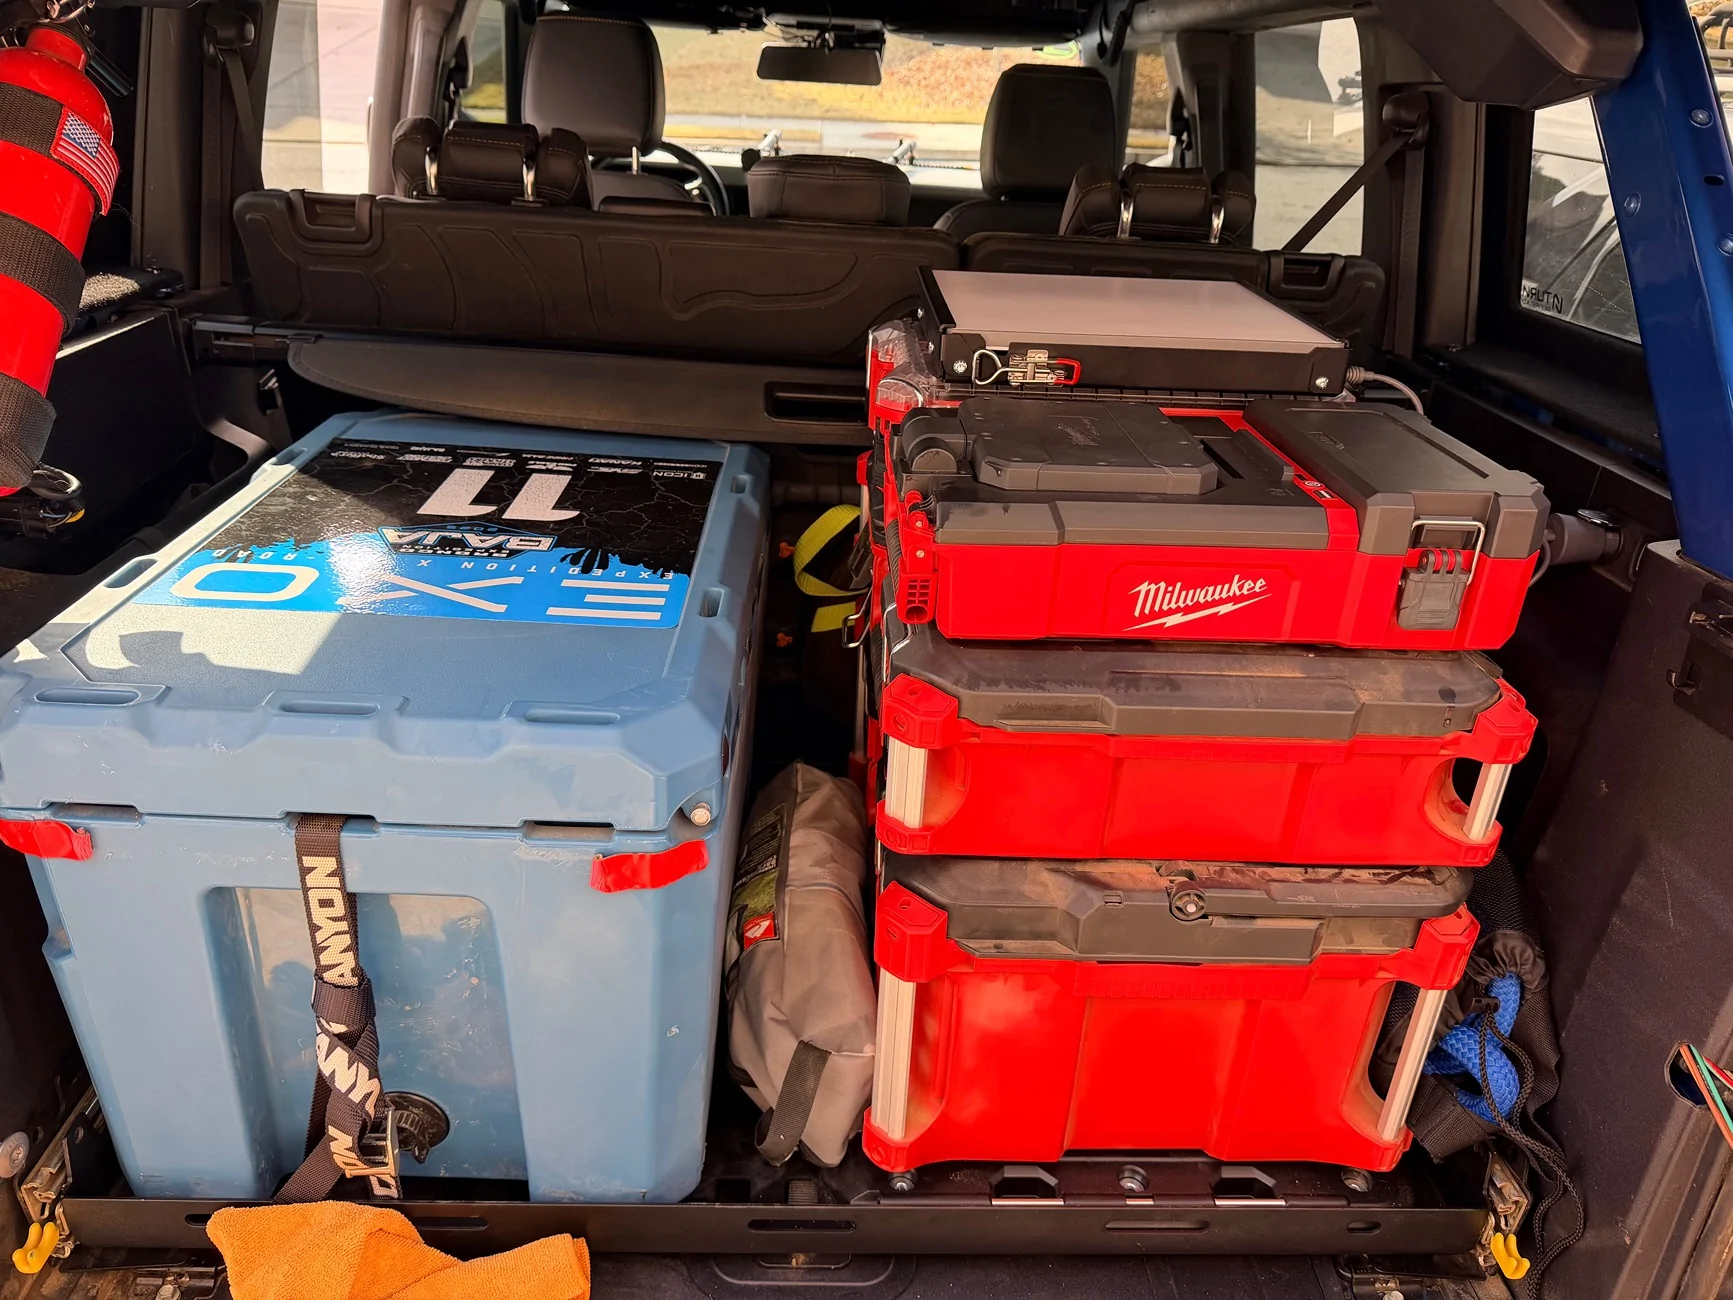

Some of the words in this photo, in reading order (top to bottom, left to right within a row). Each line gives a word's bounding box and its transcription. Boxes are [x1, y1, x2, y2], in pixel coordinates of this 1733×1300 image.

[416, 469, 582, 521] 11
[381, 529, 553, 551] BAJA
[417, 559, 430, 567] X
[461, 560, 675, 579] EXPEDITION
[170, 562, 670, 621] EXO
[1128, 574, 1269, 617] Milwaukee
[301, 856, 361, 988] ANYON
